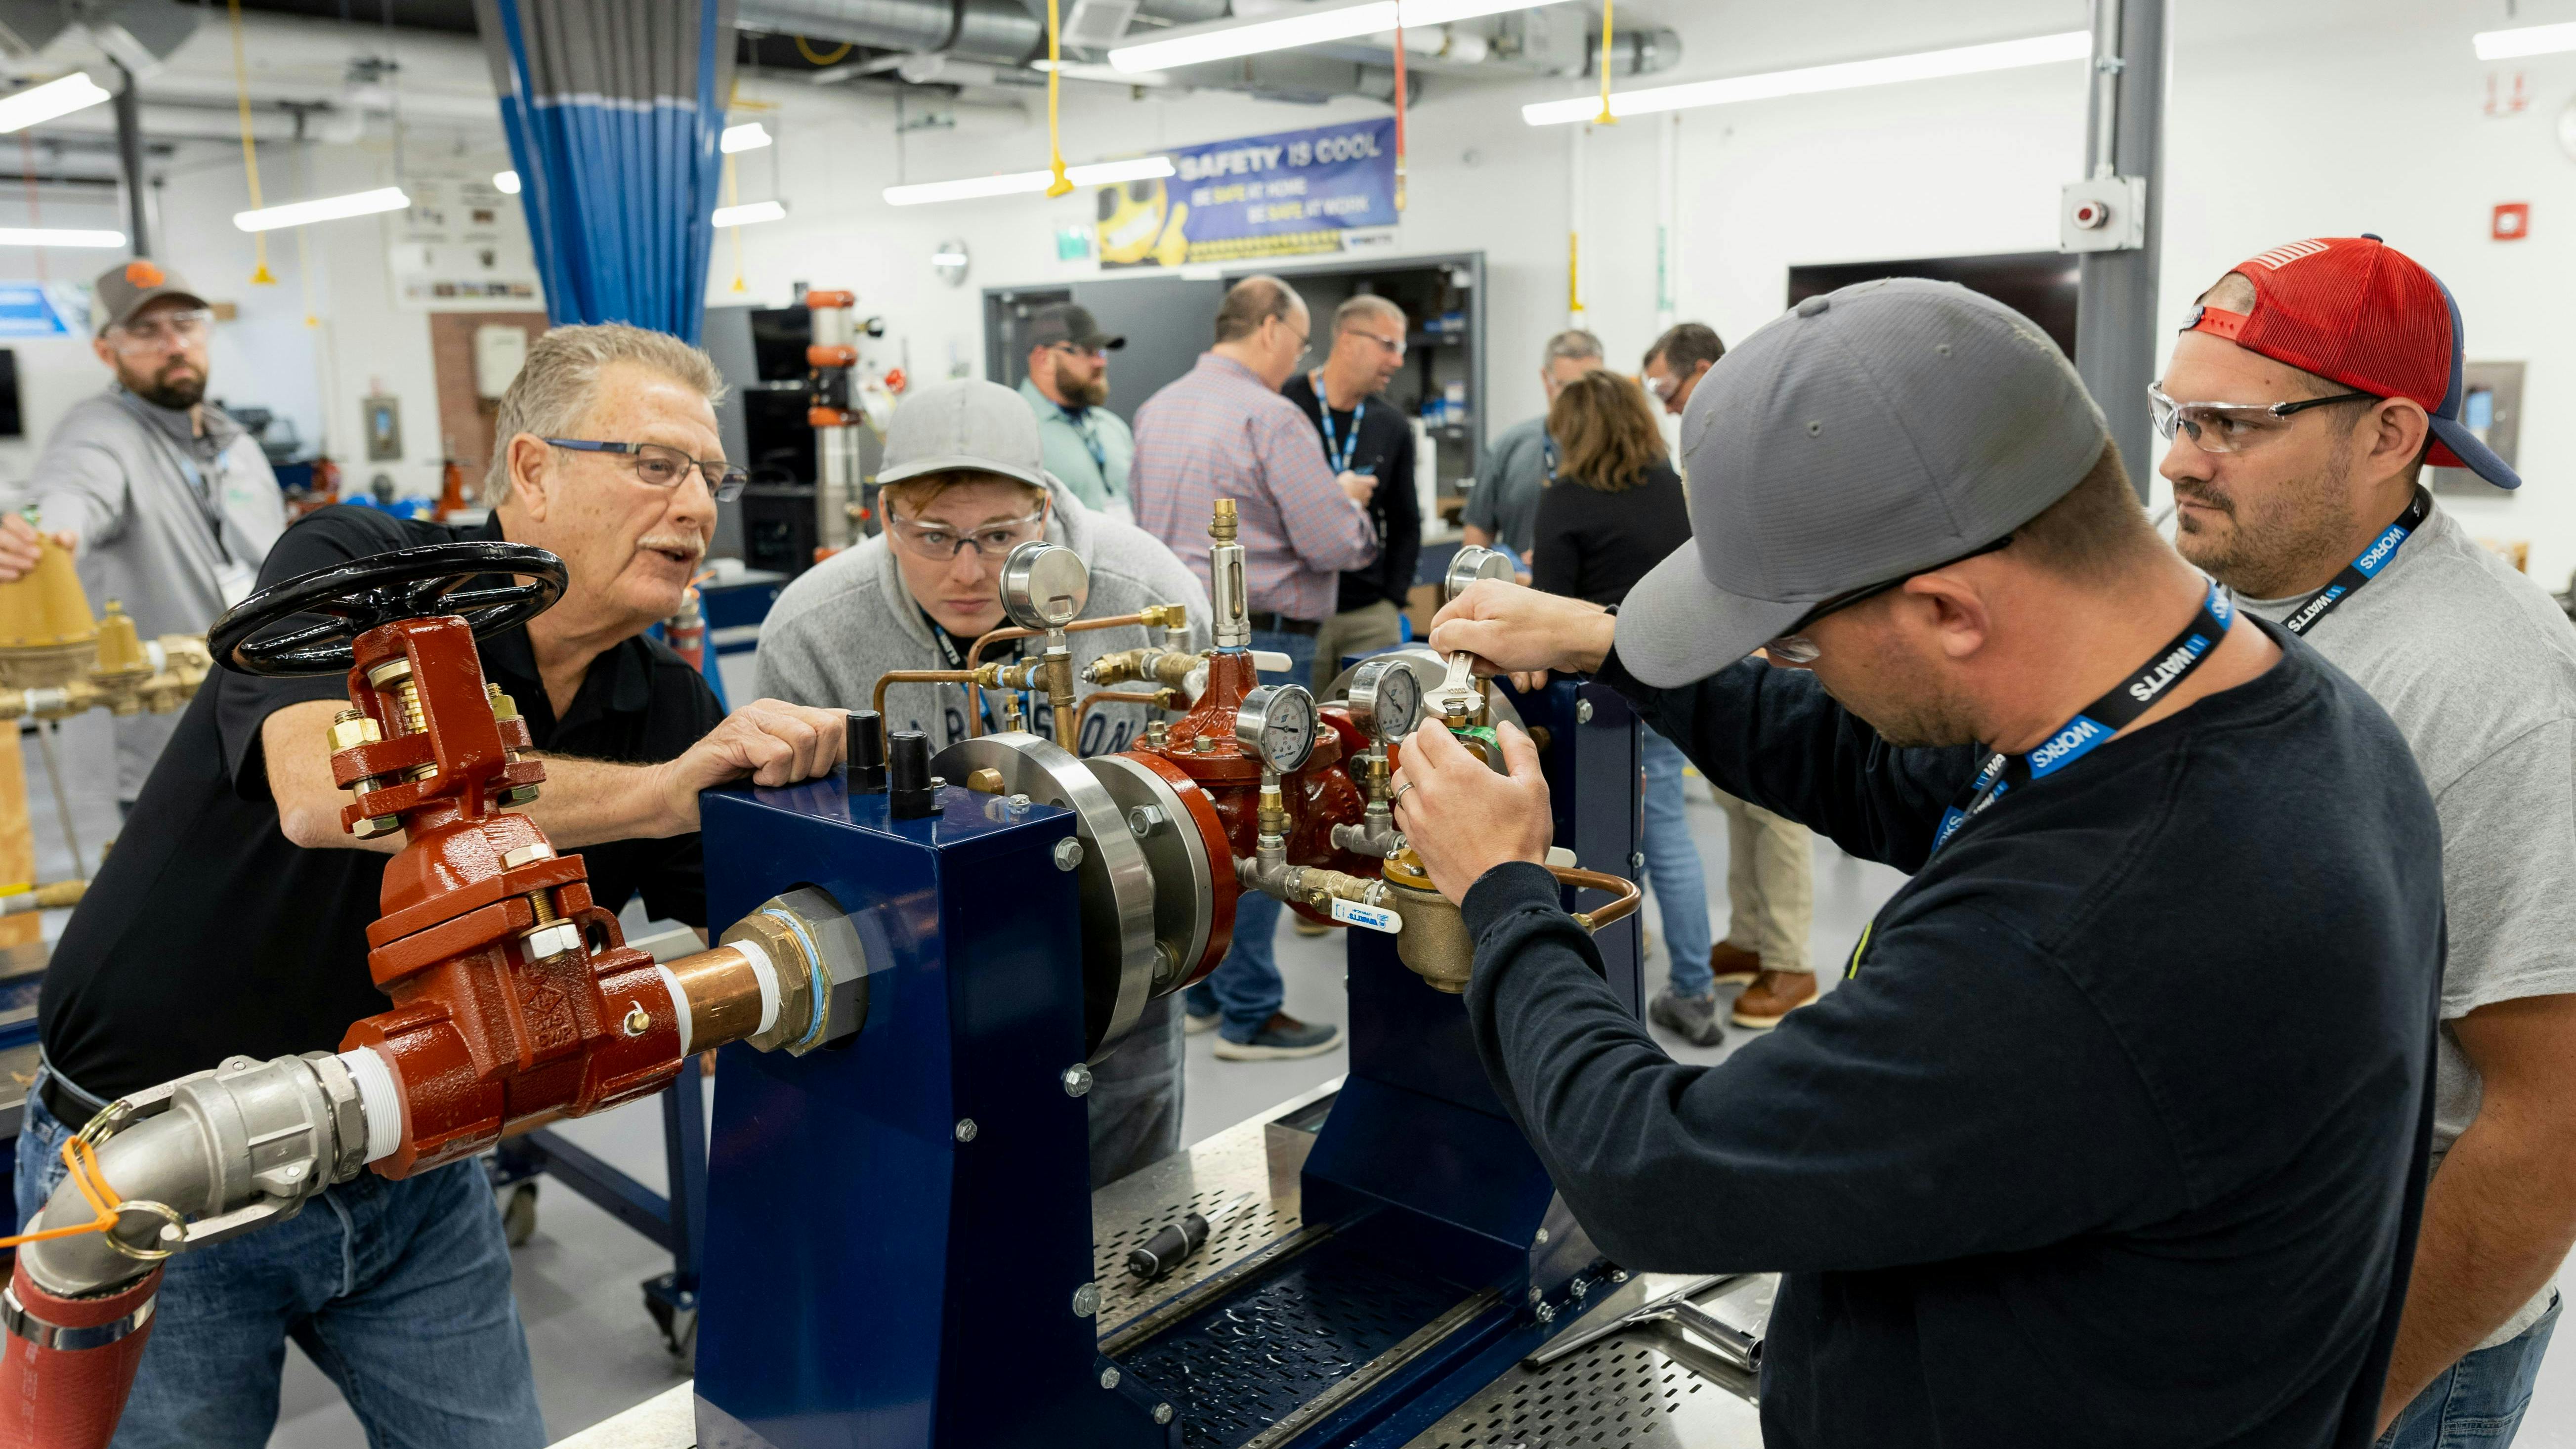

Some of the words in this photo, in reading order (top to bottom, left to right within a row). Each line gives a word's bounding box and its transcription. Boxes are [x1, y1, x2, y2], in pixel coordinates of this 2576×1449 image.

[1180, 147, 1281, 181] SAFETY
[1288, 140, 1311, 167] IS
[1316, 134, 1380, 164] COOL
[2360, 527, 2405, 569] WORKS
[2288, 595, 2332, 632] WATTS
[2129, 647, 2197, 701] WATTS
[2031, 721, 2100, 768] WORKS
